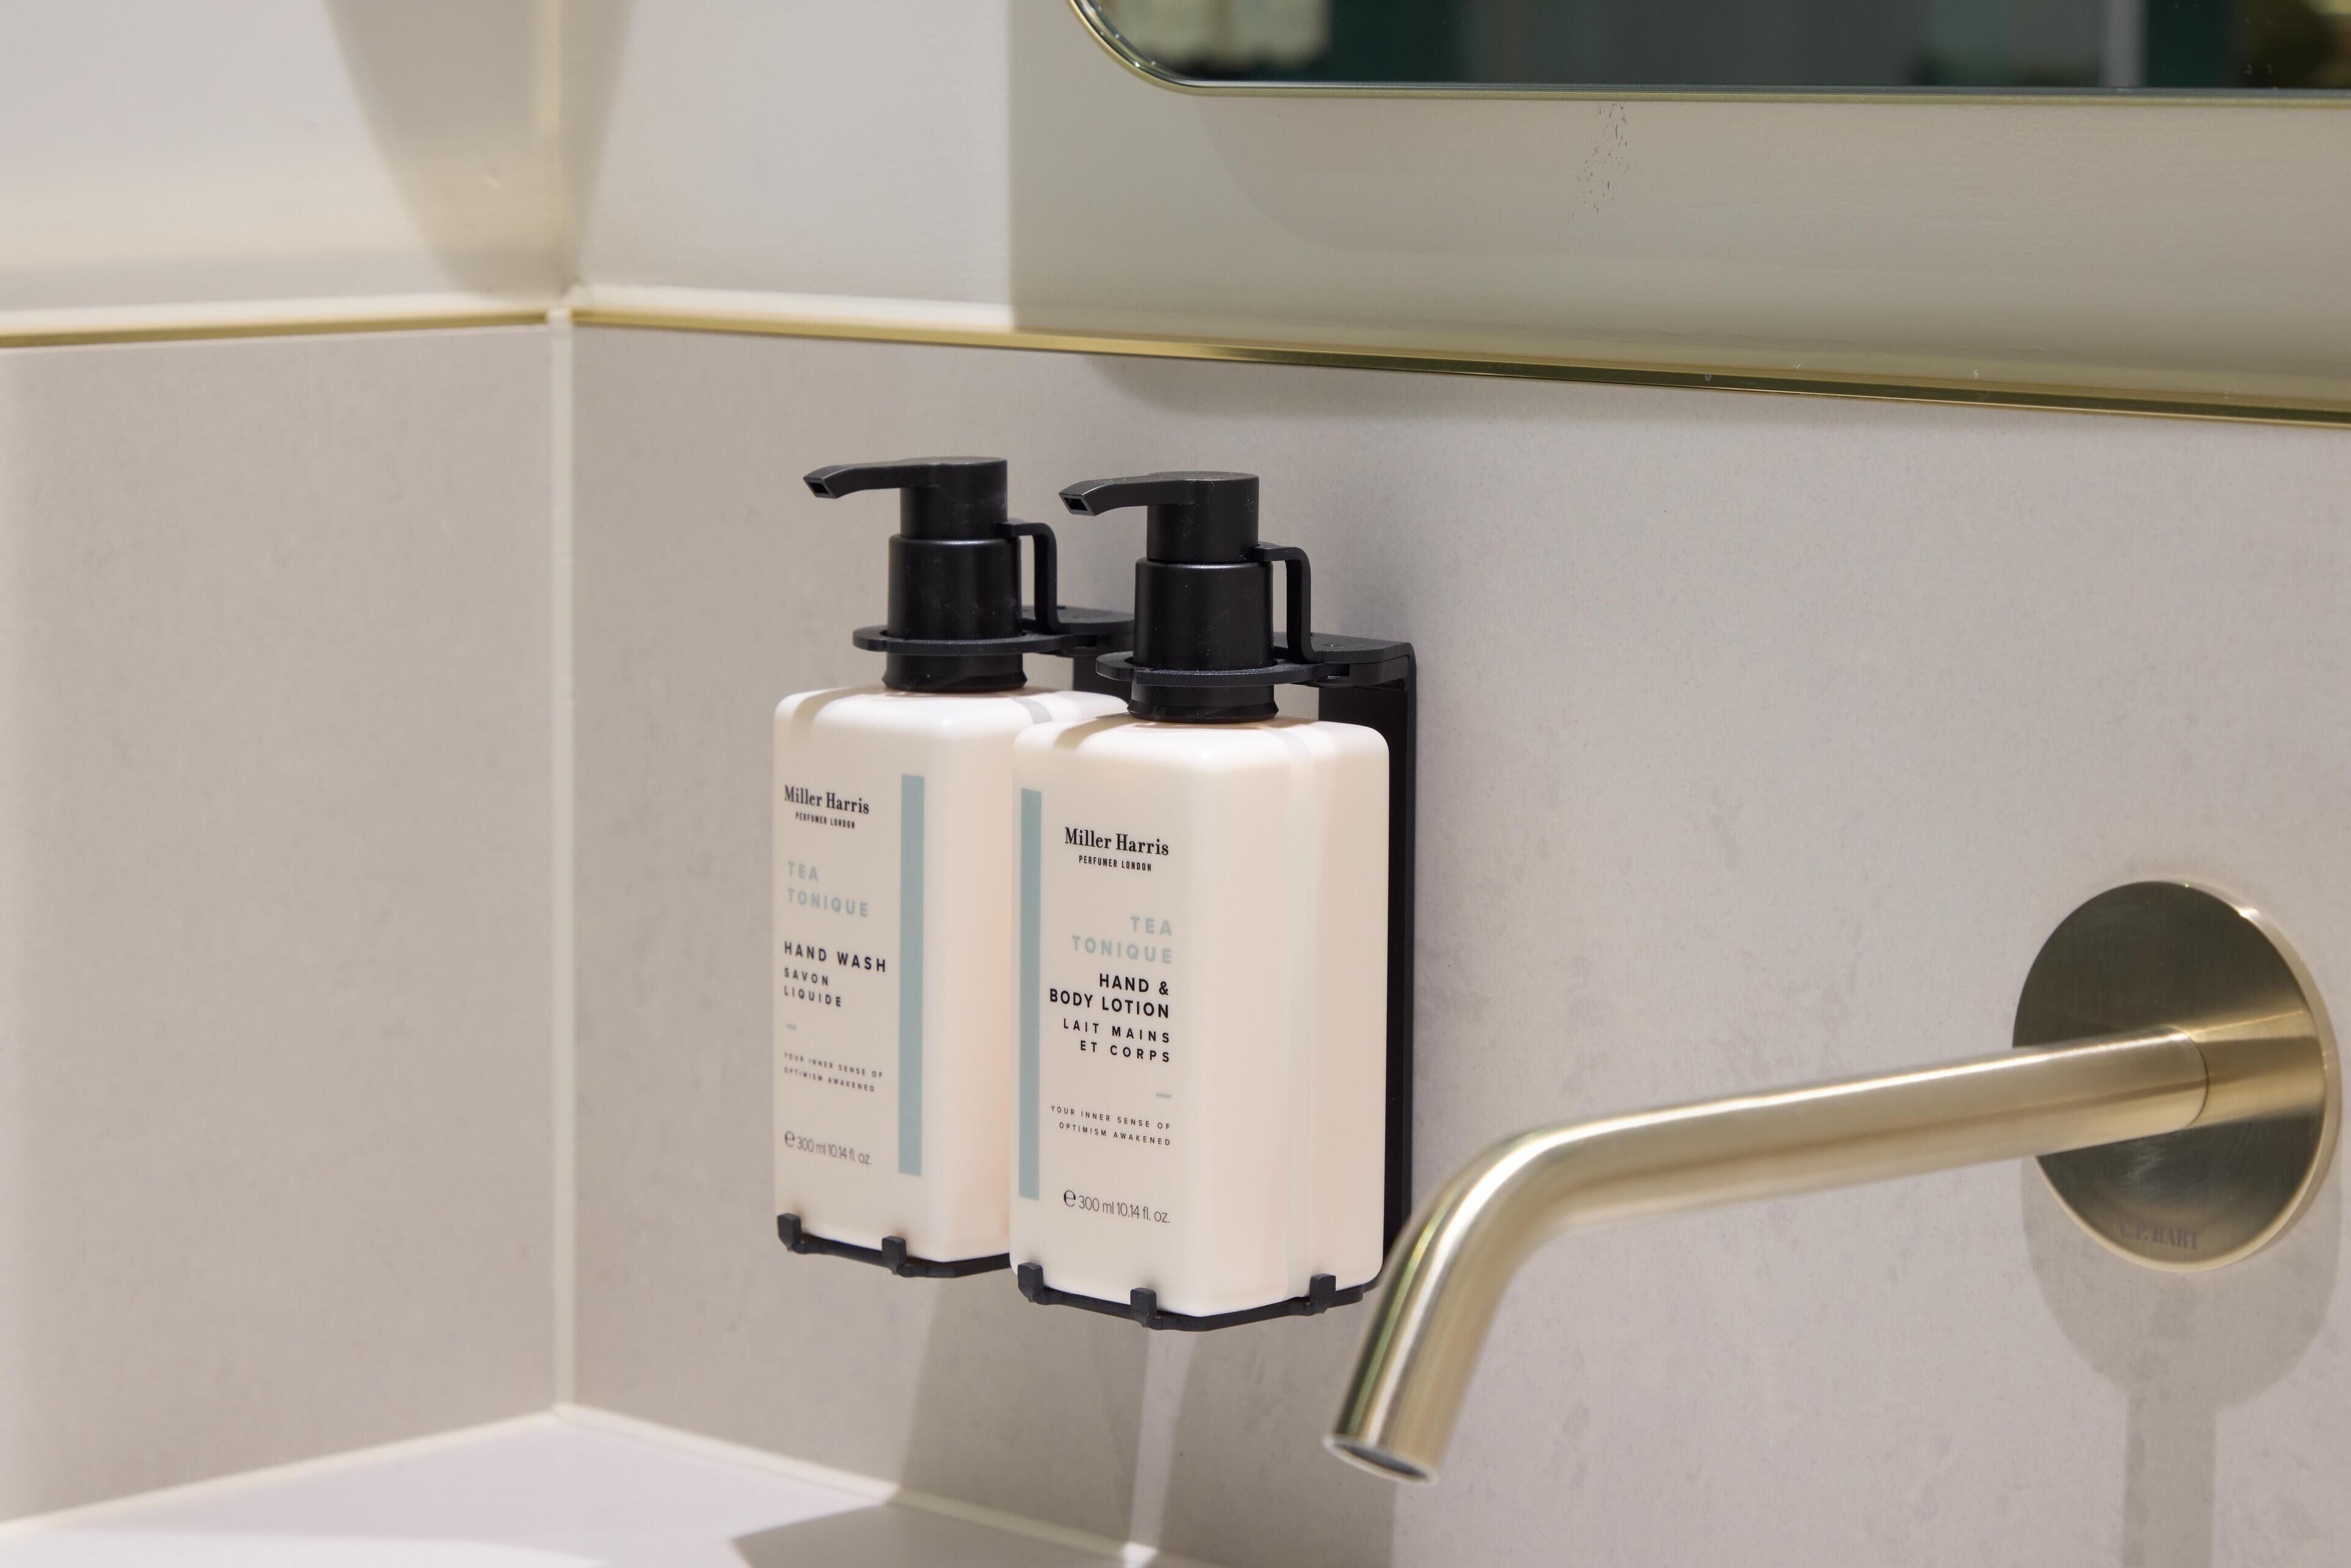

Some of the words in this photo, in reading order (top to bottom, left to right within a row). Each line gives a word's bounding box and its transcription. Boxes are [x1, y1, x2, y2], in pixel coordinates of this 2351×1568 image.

[784, 784, 822, 806] Miller
[826, 792, 869, 814] Harris
[795, 812, 827, 825] PERFUMER
[830, 818, 855, 829] LONDON
[1065, 827, 1112, 849] Miller
[1116, 833, 1169, 856] Harris
[788, 861, 818, 881] TEA
[1079, 855, 1117, 868] PERFUMER
[1122, 860, 1152, 872] LONDON
[788, 888, 868, 917] TONIQUE
[1130, 916, 1172, 936] TEA
[784, 940, 827, 961] HAND
[837, 951, 885, 972] WASH
[1072, 936, 1171, 964] TONIQUE
[784, 967, 828, 986] SAVON
[1100, 973, 1149, 992] HAND
[1159, 981, 1169, 996] &
[784, 986, 841, 1007] LIQUIDE
[1050, 988, 1093, 1008] BODY
[1102, 997, 1168, 1018] LOTION
[1063, 1018, 1099, 1033] LAIT
[1112, 1026, 1169, 1043] MAINS
[1081, 1040, 1097, 1052] ET
[1110, 1045, 1169, 1062] CORPS
[784, 1052, 803, 1062] YOUR
[809, 1058, 833, 1068] INNER
[839, 1064, 865, 1076] SENSE
[784, 1067, 822, 1081] OPTIMISM
[828, 1078, 874, 1092] AWAKENED
[1051, 1105, 1074, 1116] YOUR
[1081, 1111, 1110, 1122] INNER
[1117, 1116, 1150, 1127] SENSE
[797, 1136, 814, 1152] 300
[1059, 1122, 1106, 1136] OPTIMISM
[1113, 1131, 1170, 1146] AWAKENED
[1078, 1195, 1100, 1212] 300
[1102, 1201, 1114, 1215] ml
[1117, 1202, 1140, 1219] 10.14
[1142, 1206, 1151, 1221] fl.
[1154, 1211, 1170, 1223] oz.
[2152, 1226, 2200, 1250] HART
